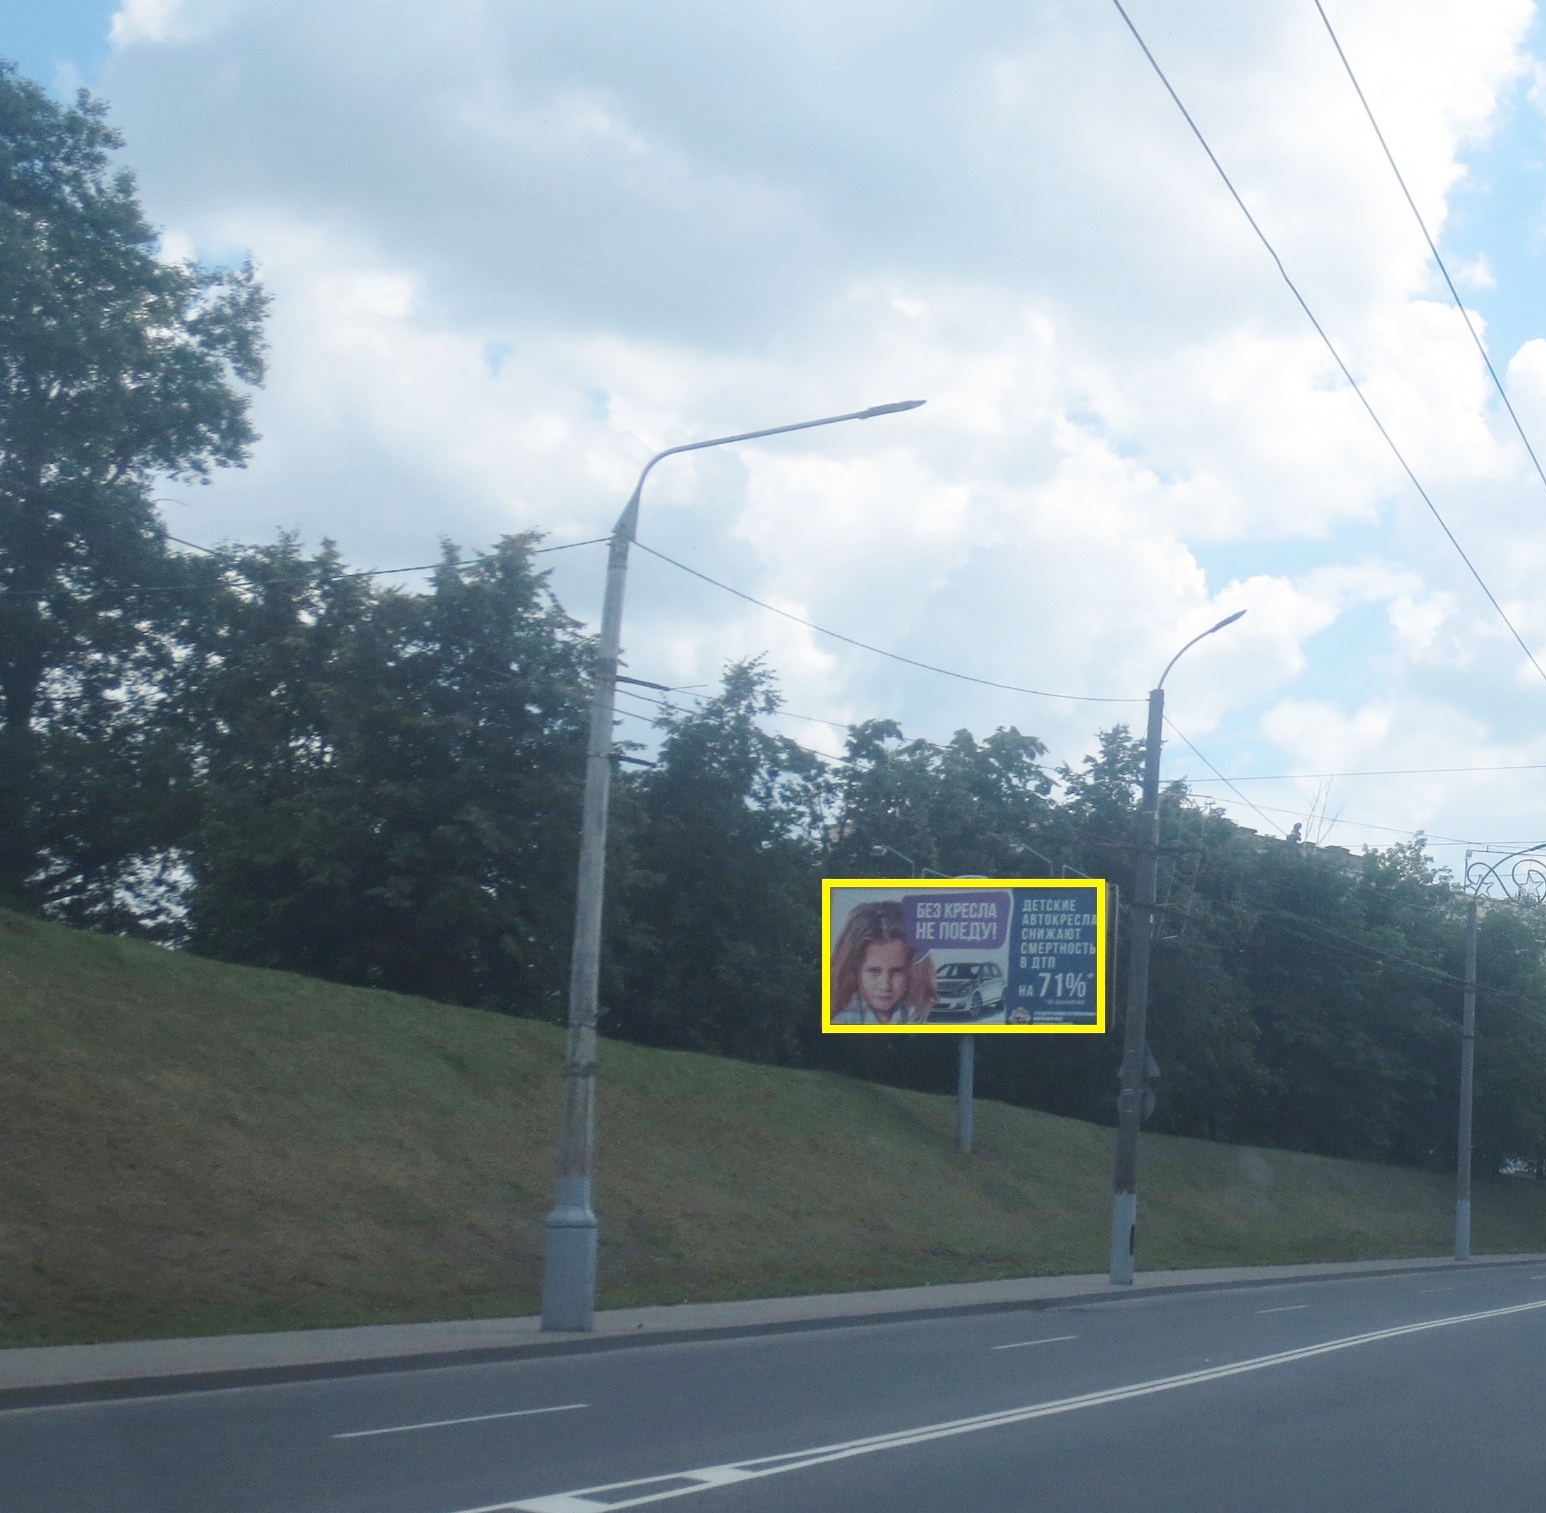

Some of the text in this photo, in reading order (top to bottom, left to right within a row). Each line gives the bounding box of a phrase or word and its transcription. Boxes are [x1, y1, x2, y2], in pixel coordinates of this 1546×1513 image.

[916, 902, 997, 918] БЕЗ КРЕСЛА
[1022, 899, 1076, 912] ДЕТСКИЕ
[1022, 913, 1097, 926] АВТОКРЕСЛА
[916, 921, 997, 941] НЕ ПОЕДУ!
[1021, 928, 1082, 940] СНИЖАЮТ
[1020, 942, 1096, 955] СМЕРТНОСТЬ
[1020, 956, 1056, 970] В ДТП
[1018, 984, 1034, 997] НА
